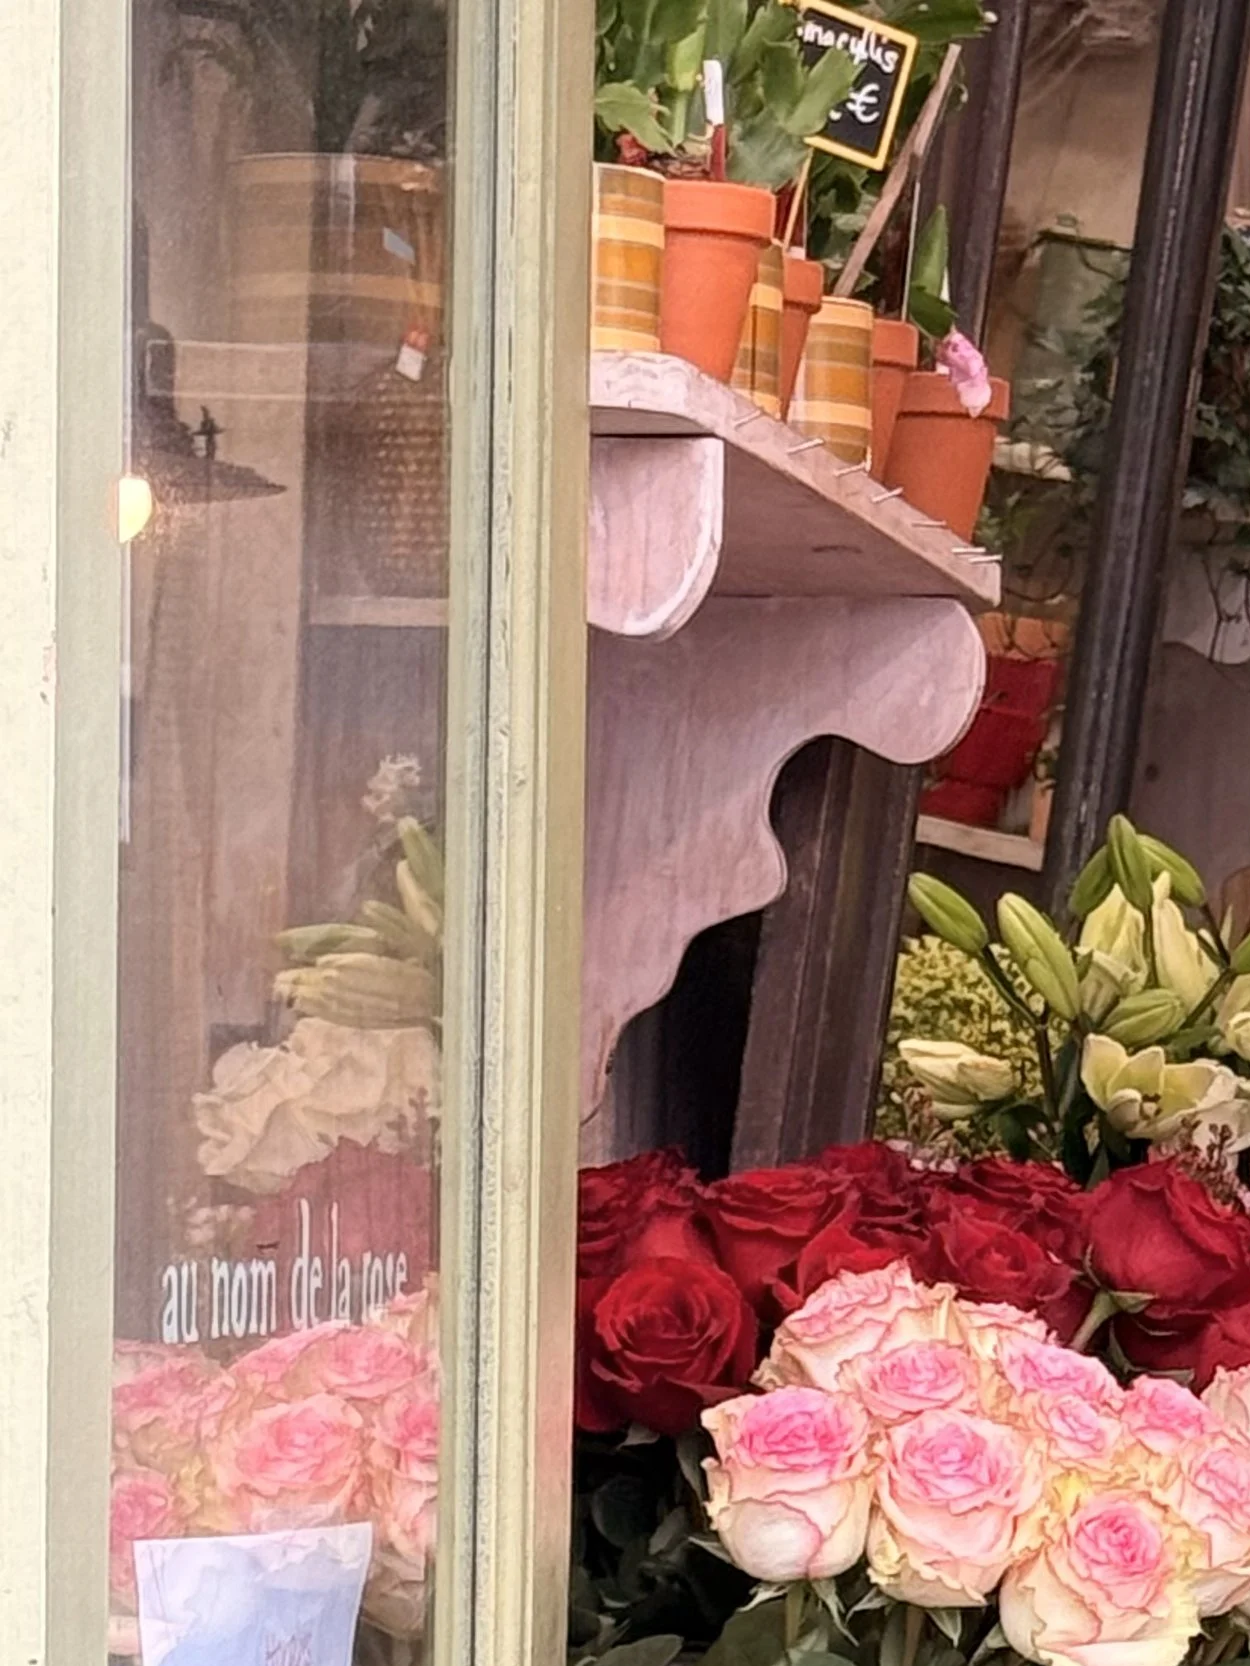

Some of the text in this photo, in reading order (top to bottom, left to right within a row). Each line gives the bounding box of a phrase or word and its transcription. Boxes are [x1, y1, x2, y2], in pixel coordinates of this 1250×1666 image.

[796, 21, 899, 73] maryllis
[162, 1260, 199, 1344] au
[211, 1256, 277, 1339] nom
[291, 1198, 323, 1330] de
[331, 1201, 351, 1328] la
